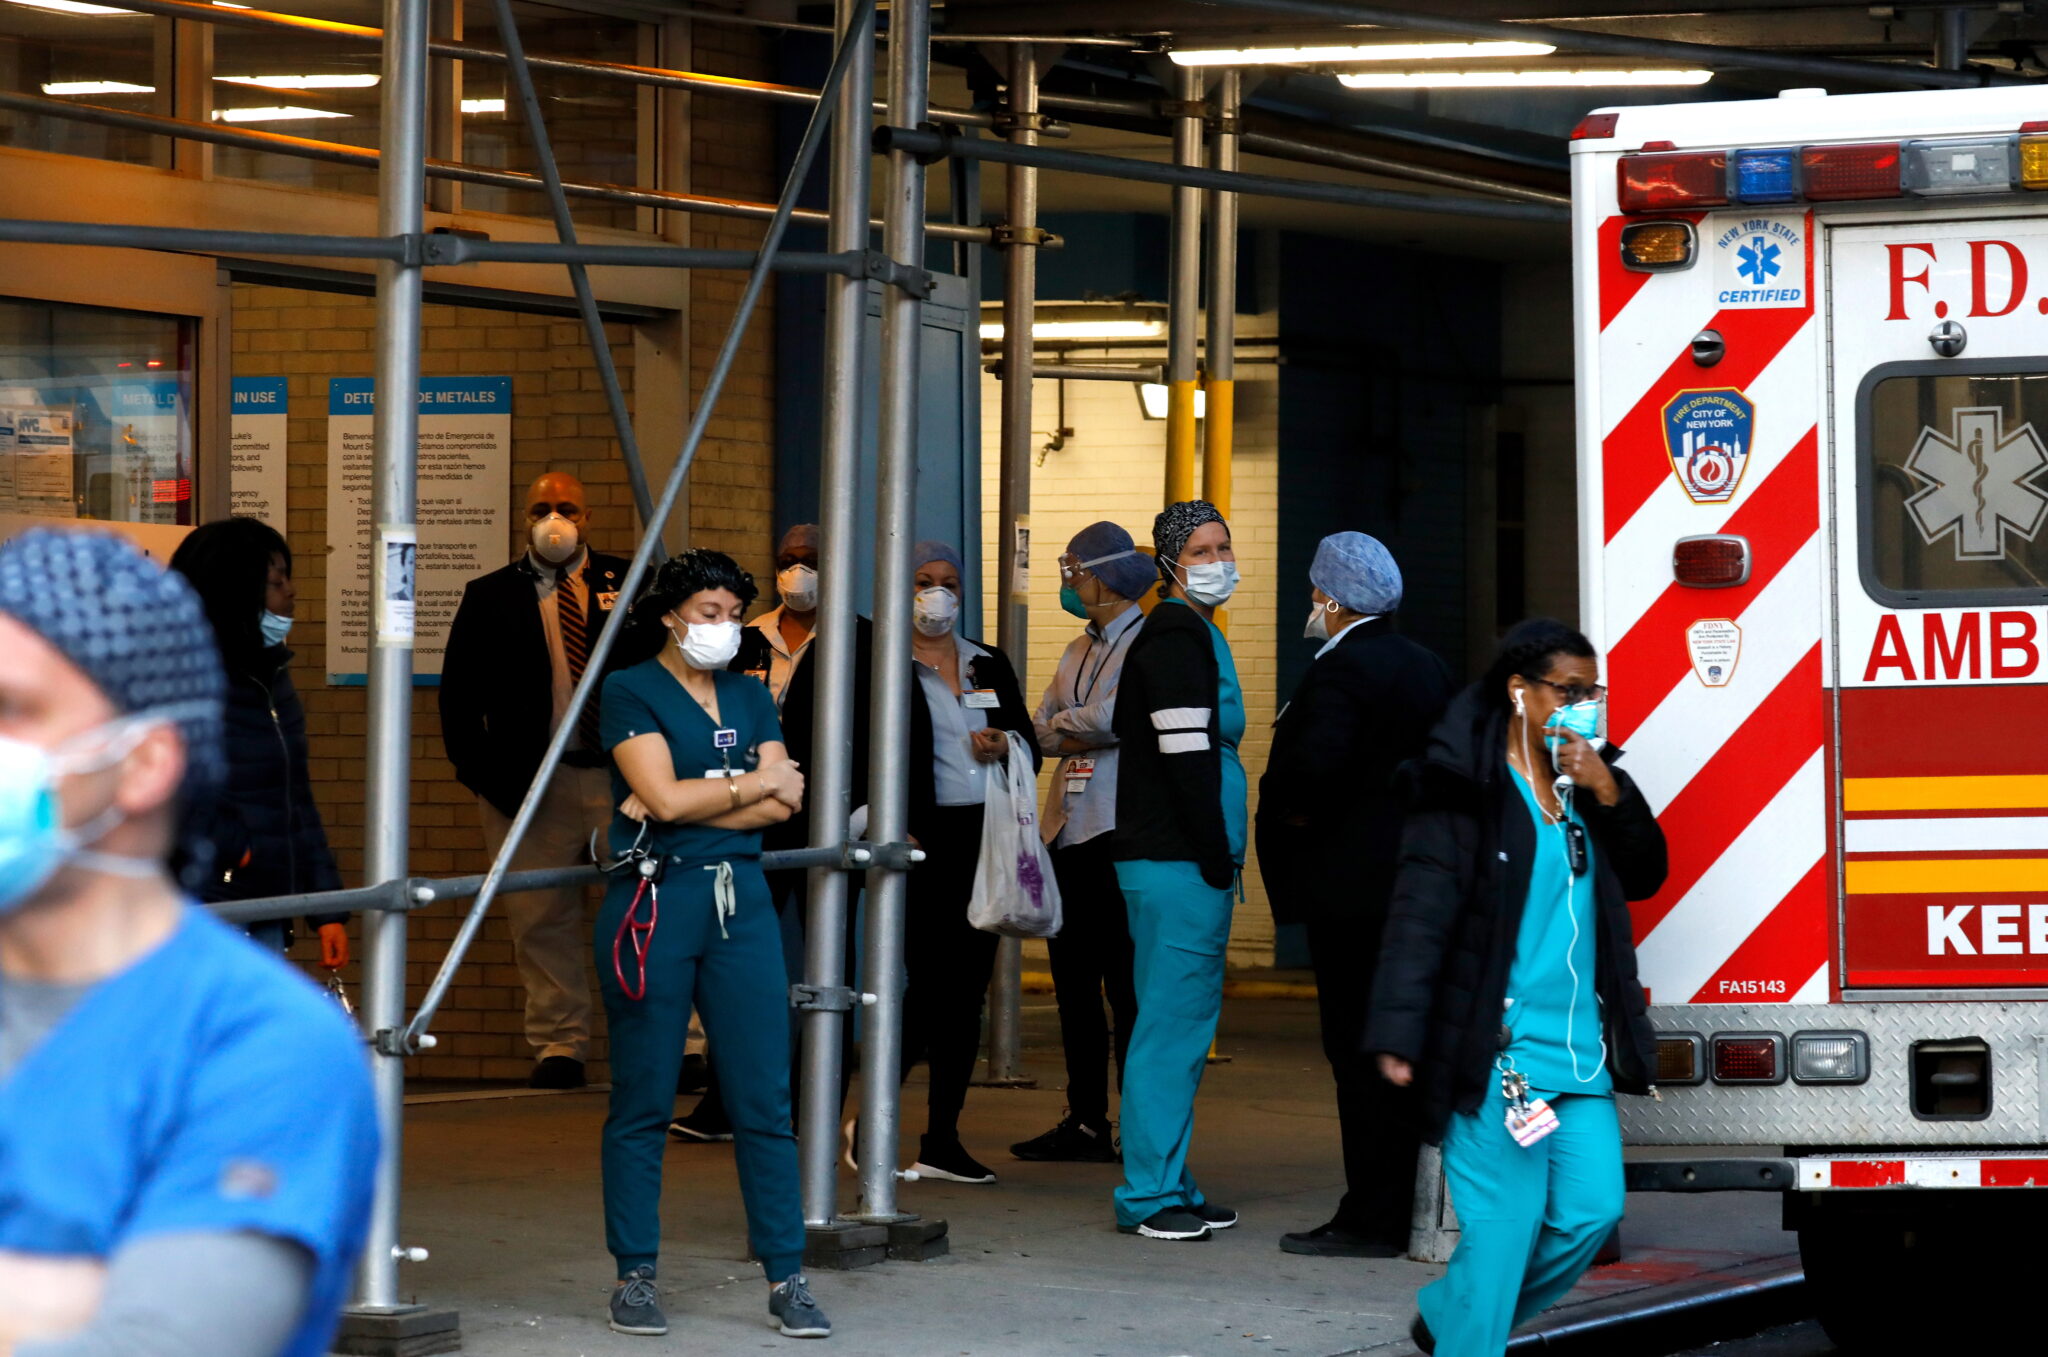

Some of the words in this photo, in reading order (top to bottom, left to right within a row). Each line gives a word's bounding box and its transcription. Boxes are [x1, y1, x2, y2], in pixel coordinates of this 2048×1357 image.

[1717, 226, 1740, 249] NEW
[1741, 219, 1770, 232] YORK
[1772, 222, 1801, 247] STATE
[1718, 288, 1802, 303] CERTIFIED
[234, 391, 248, 404] IN
[250, 391, 277, 403] USE
[436, 391, 496, 403] METALES
[1673, 404, 1691, 424] FIRE
[1689, 396, 1747, 420] DEPARTMENT
[1692, 409, 1712, 419] CITY
[1714, 409, 1727, 417] OF
[1686, 420, 1707, 429] NEW
[1708, 419, 1734, 428] YORK
[446, 432, 484, 441] Emergencia
[232, 443, 270, 451] committed
[1862, 610, 2048, 682] AMB
[1719, 980, 1786, 994] FA15143
